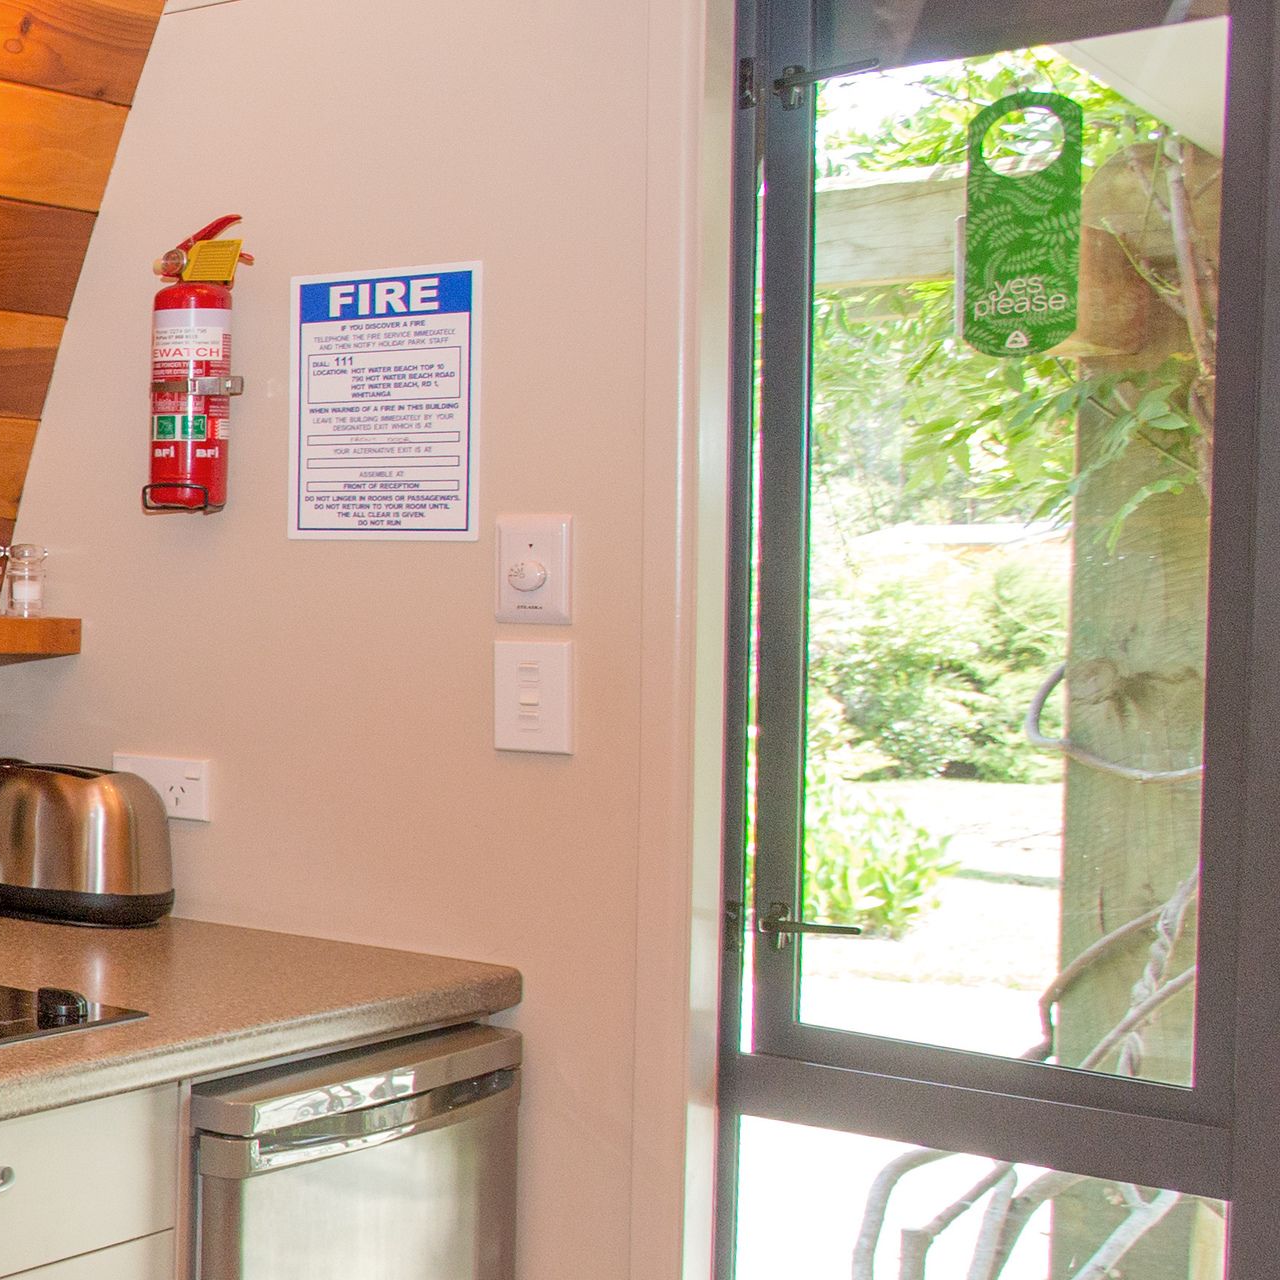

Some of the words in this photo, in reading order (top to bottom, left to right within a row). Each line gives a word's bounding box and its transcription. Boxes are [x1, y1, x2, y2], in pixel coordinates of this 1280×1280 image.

[989, 277, 1043, 301] yes
[329, 278, 439, 318] FIRE
[974, 294, 1066, 321] please
[314, 335, 349, 343] TELEPHONE
[334, 357, 353, 366] 111
[426, 402, 459, 410] BUILDING
[333, 424, 372, 432] DESIGNATED
